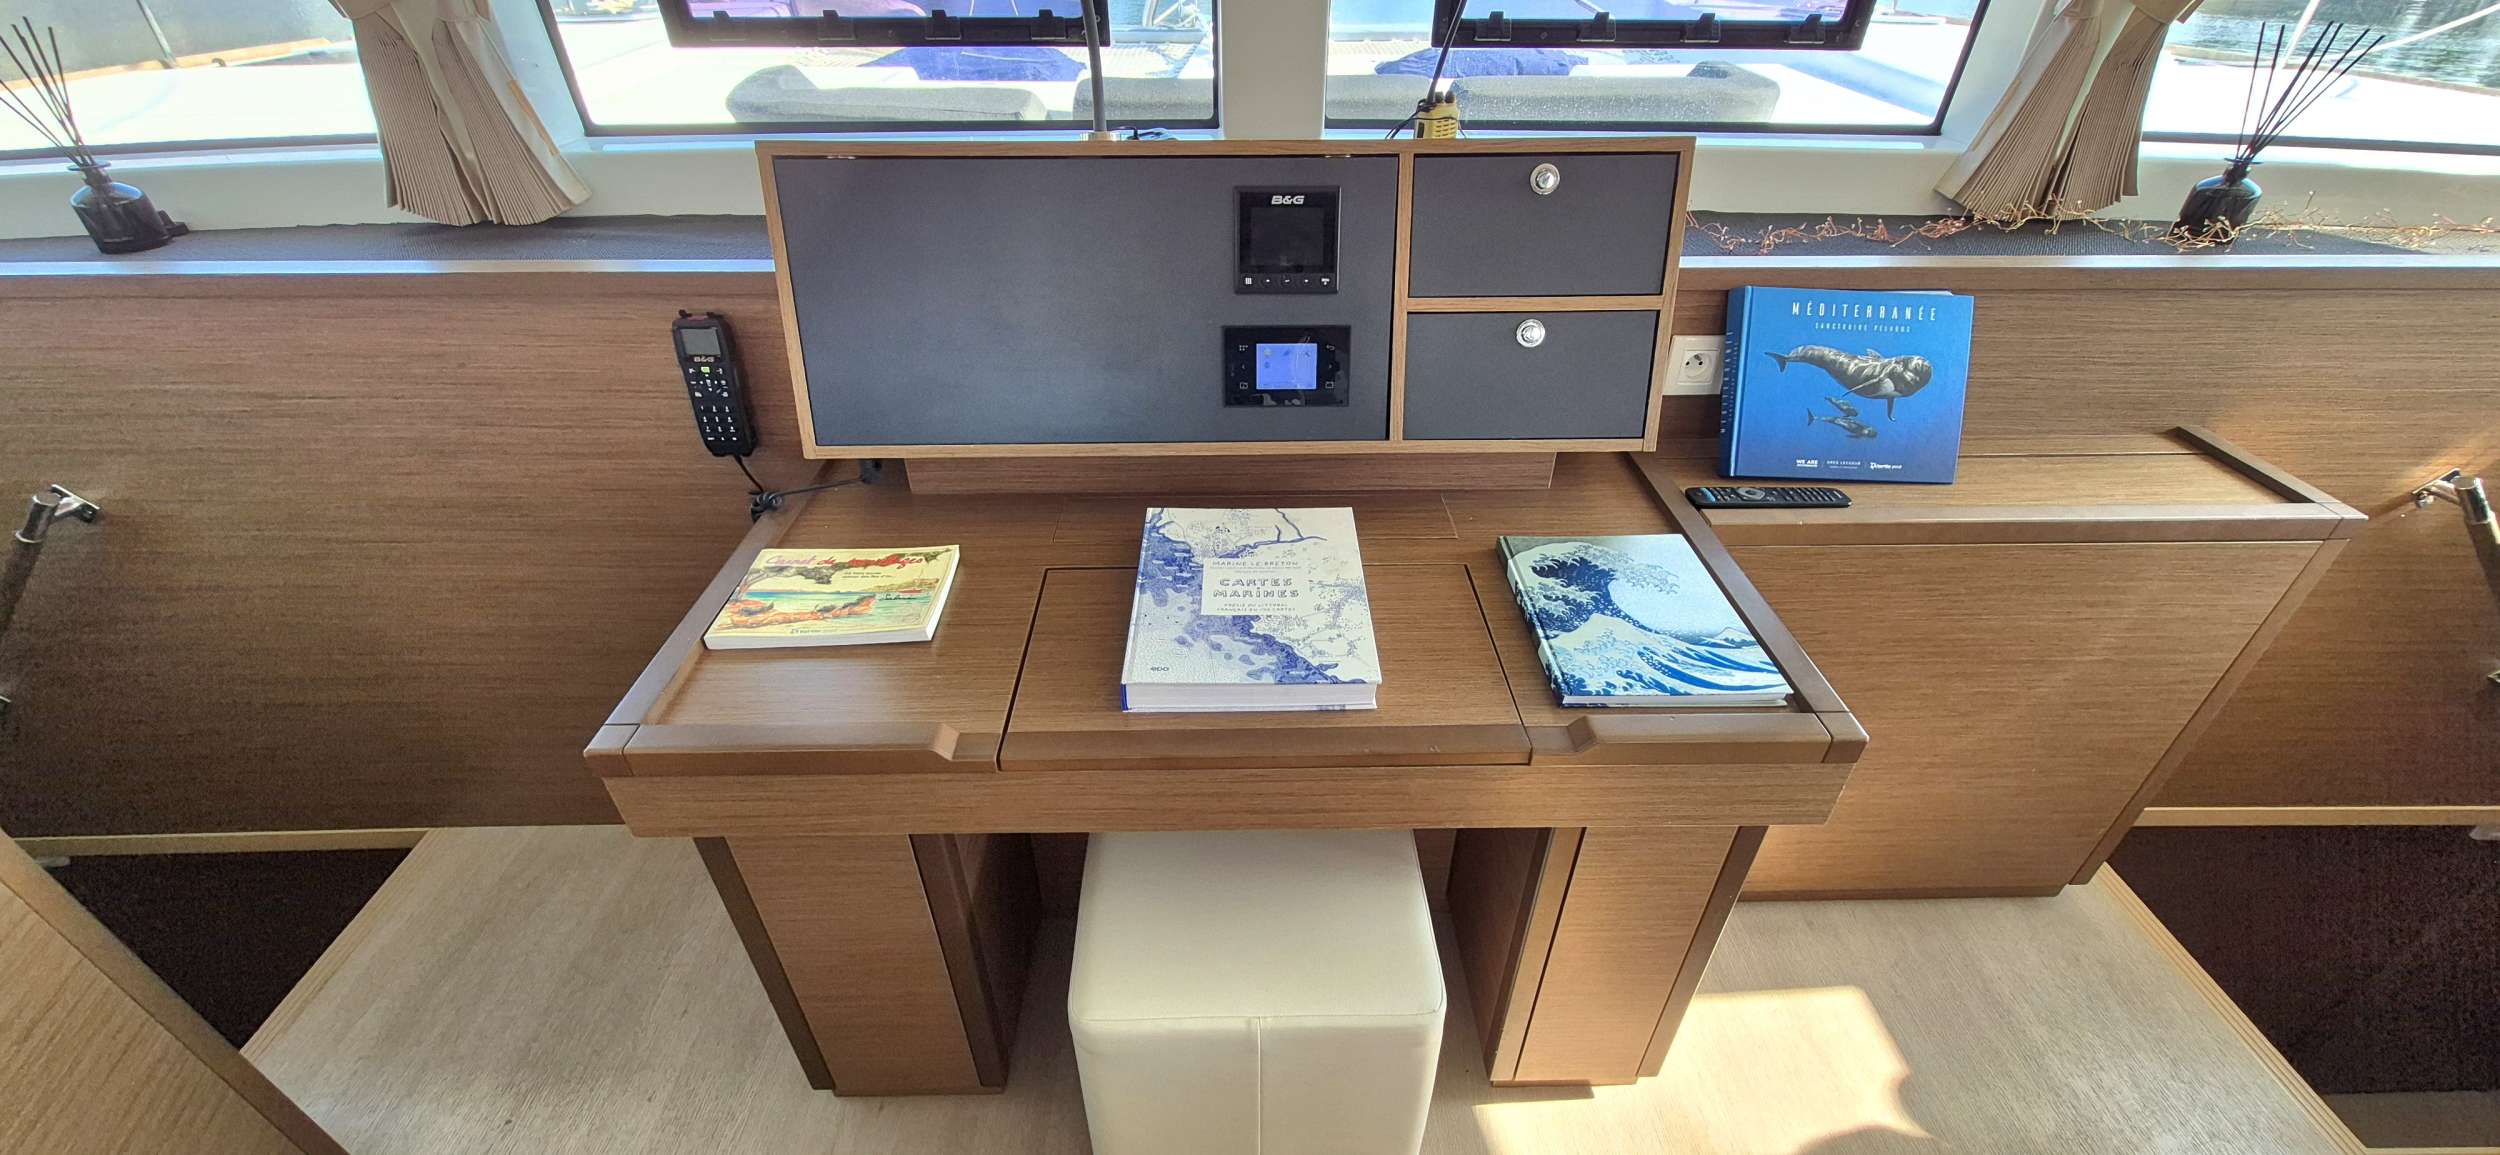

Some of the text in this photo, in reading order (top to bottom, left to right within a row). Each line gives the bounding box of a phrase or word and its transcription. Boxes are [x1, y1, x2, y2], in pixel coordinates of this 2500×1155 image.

[1271, 195, 1305, 205] B&G
[1792, 301, 1937, 321] MÉDITERRANÉE
[1219, 578, 1293, 587] CARTES
[1213, 588, 1300, 598] MARINES
